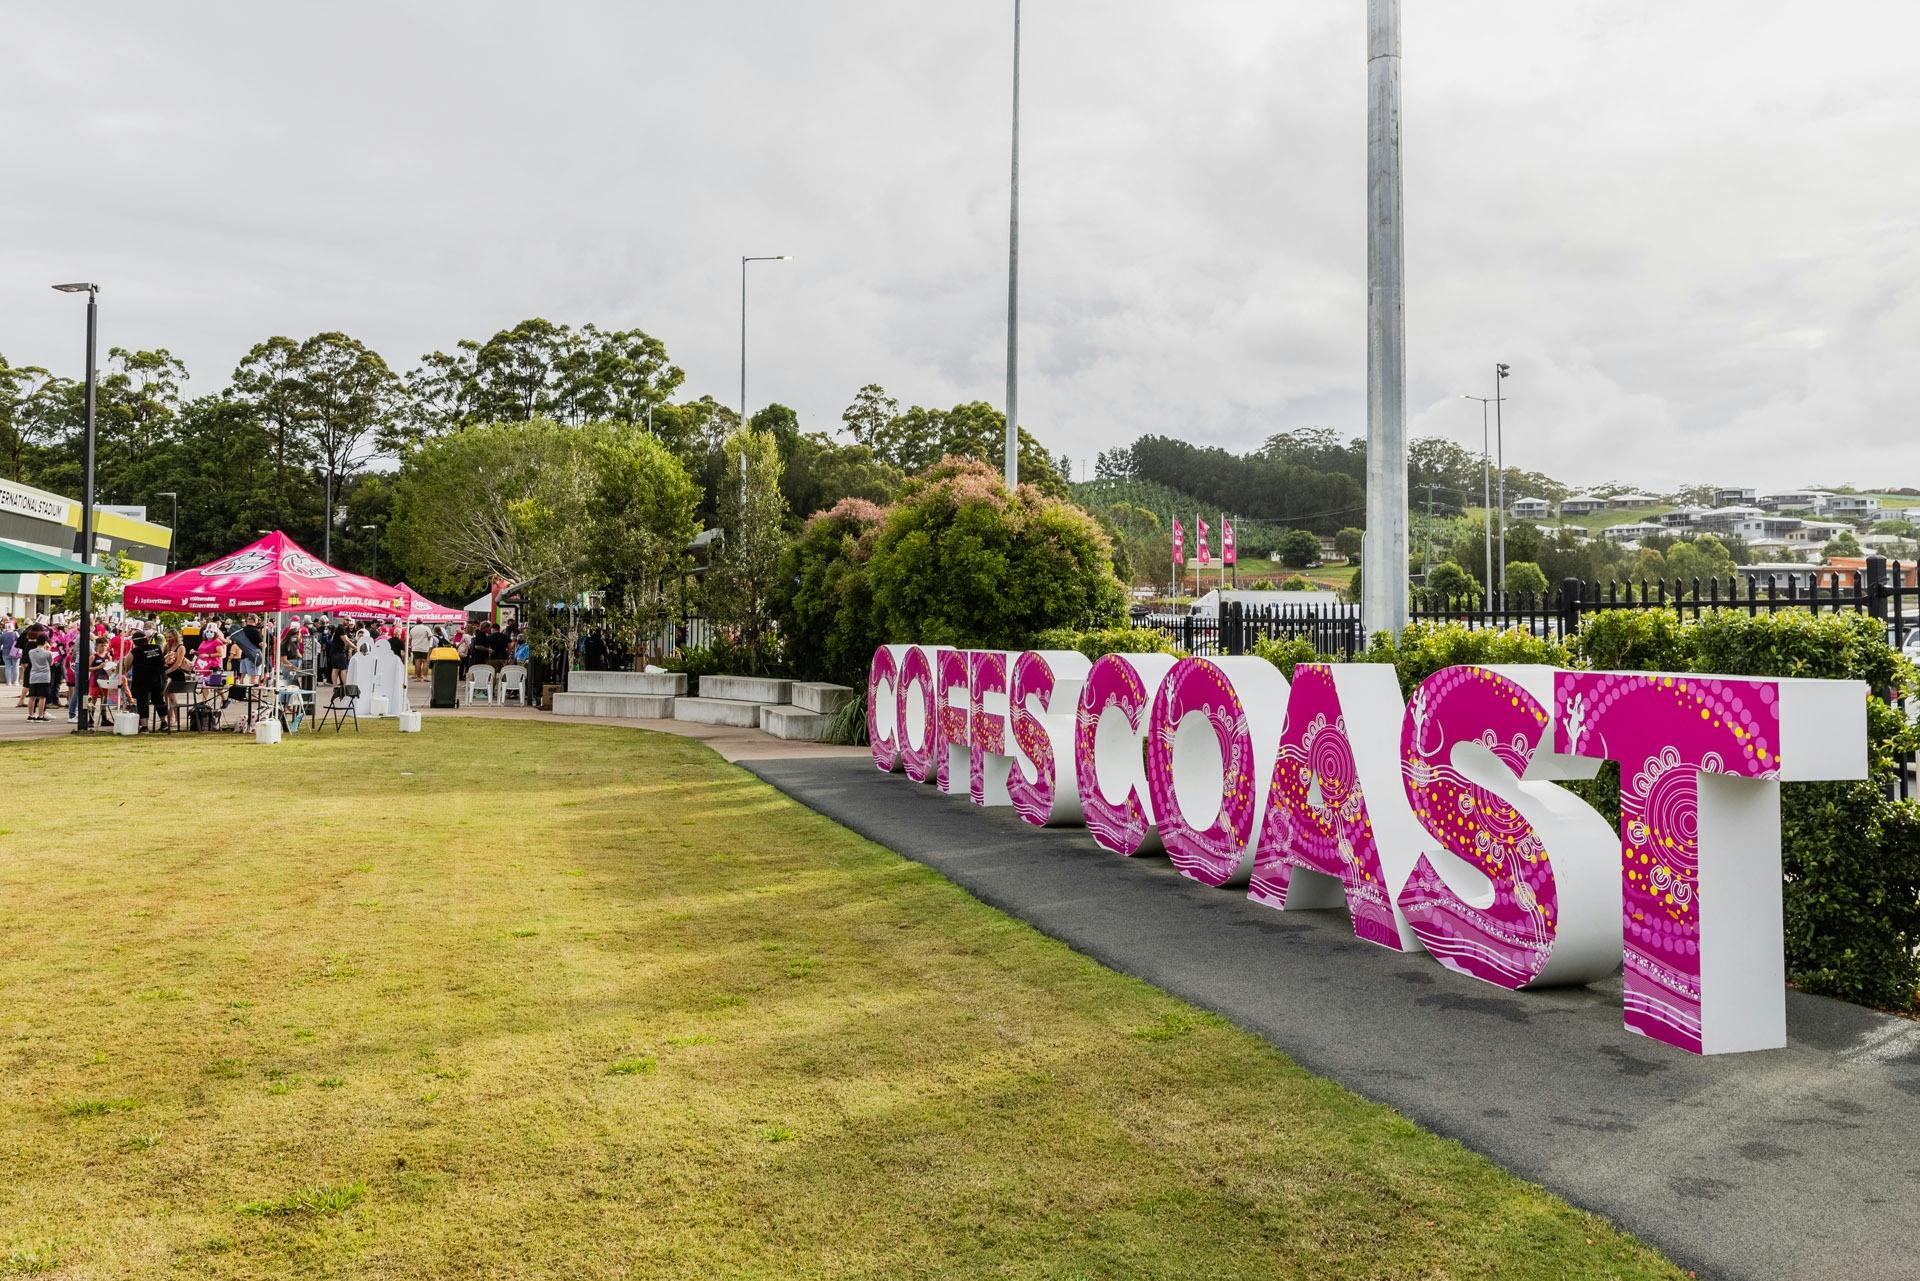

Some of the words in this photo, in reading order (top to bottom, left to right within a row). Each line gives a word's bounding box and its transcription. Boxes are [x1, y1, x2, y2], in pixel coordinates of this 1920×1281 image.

[38, 500, 62, 517] STADIUM
[868, 644, 1056, 827] COFFS
[1075, 652, 1781, 1055] COAST
